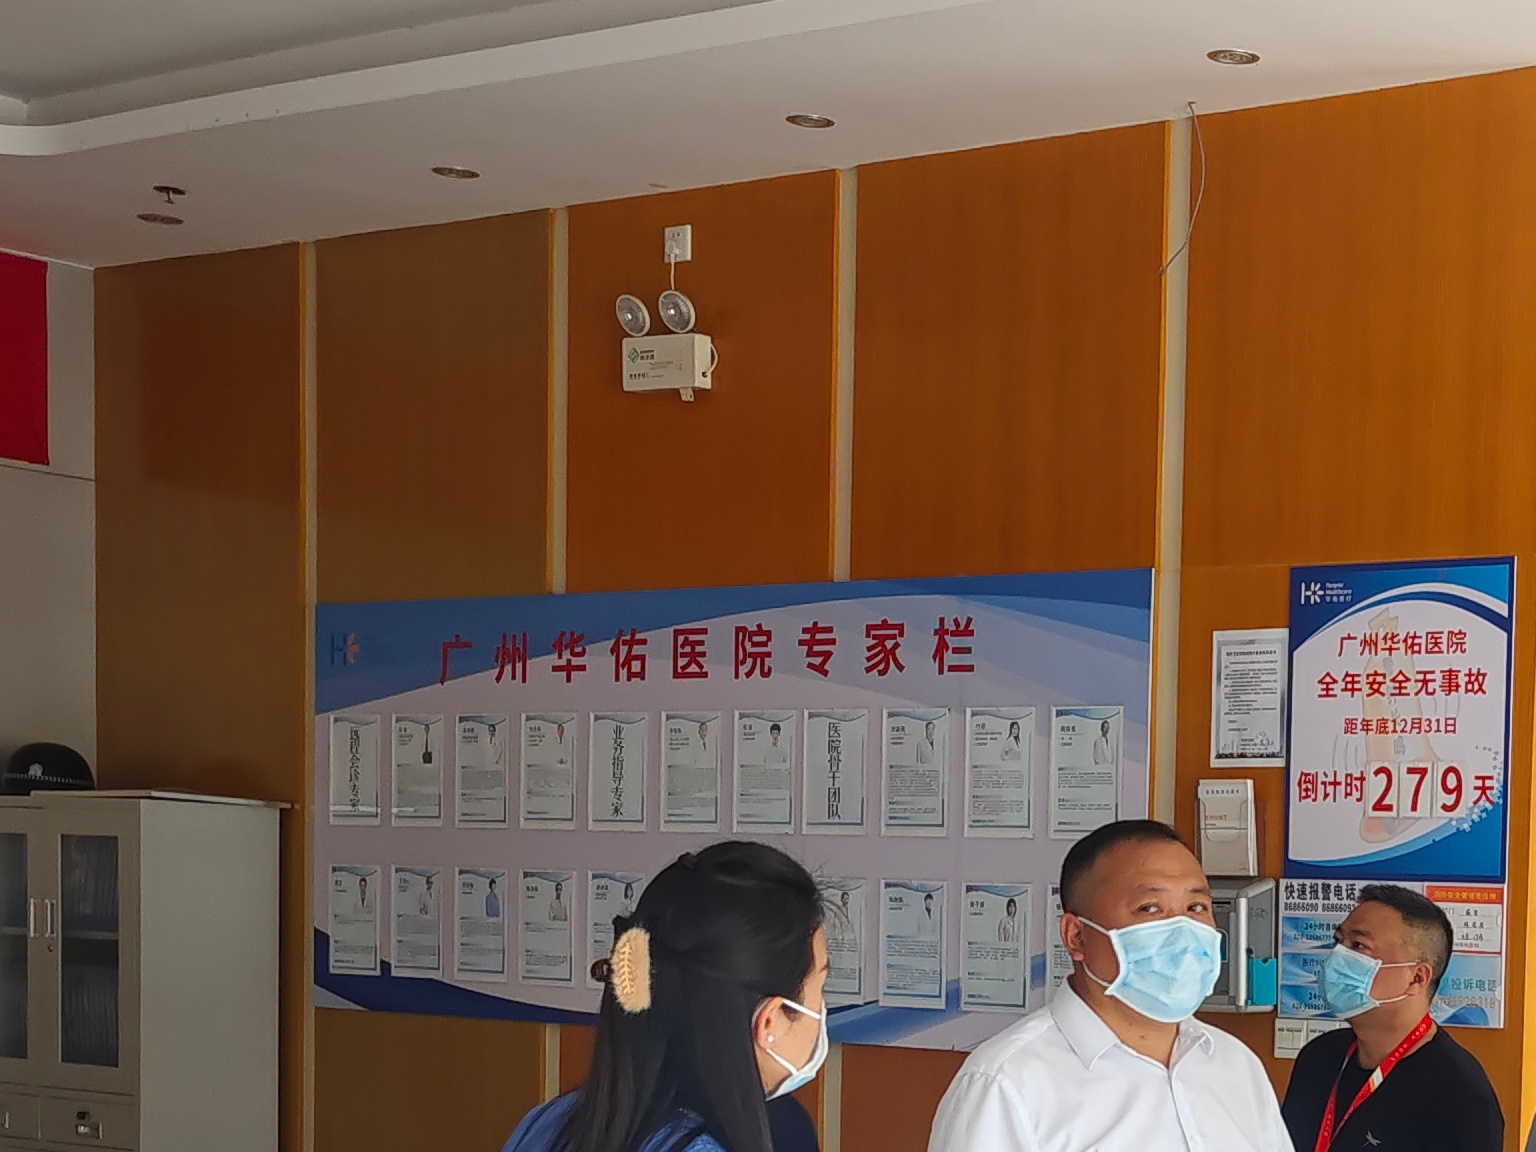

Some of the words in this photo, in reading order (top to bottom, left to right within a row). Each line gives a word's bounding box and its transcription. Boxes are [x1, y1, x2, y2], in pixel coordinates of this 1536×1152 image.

[439, 616, 976, 686] 广州华佑医院专家栏
[1337, 629, 1467, 658] 广州华佑医院
[1316, 667, 1488, 699] 全年安全无事故
[1343, 717, 1457, 735] 距年底12月31日
[611, 722, 625, 818] 业务指导专家
[827, 721, 843, 820] 医院骨干团队
[1284, 882, 1357, 901] 快速报警电话
